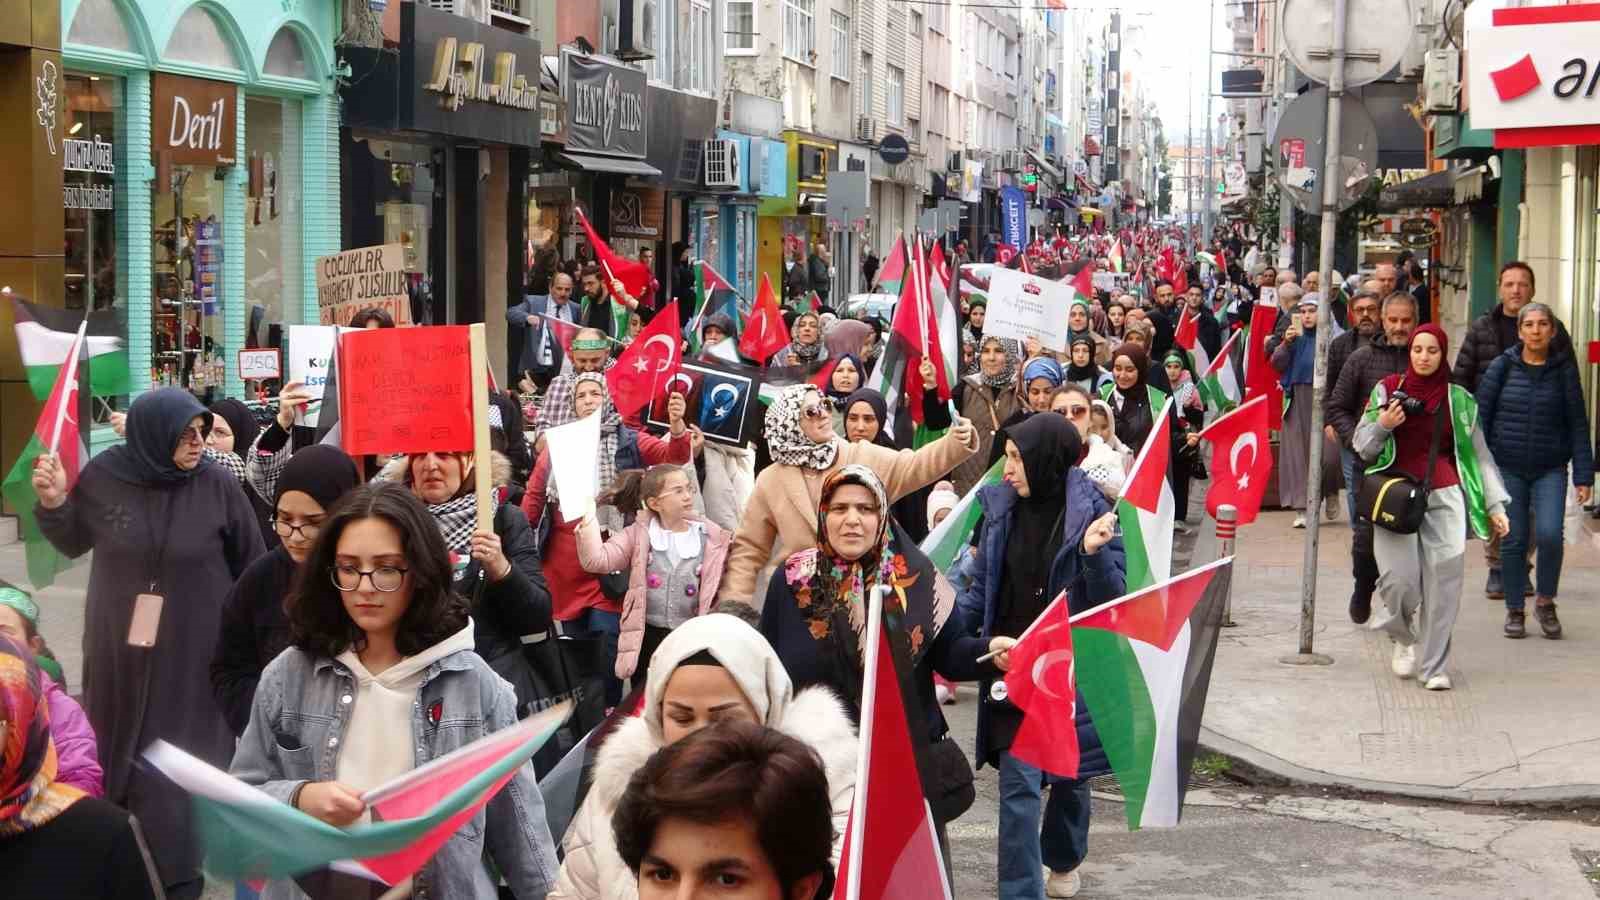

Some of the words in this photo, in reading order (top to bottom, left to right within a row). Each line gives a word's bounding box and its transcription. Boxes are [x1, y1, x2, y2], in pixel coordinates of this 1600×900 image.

[494, 51, 538, 112] Collection
[575, 80, 602, 127] KENT
[620, 93, 641, 132] KIDS
[169, 95, 224, 150] Deril
